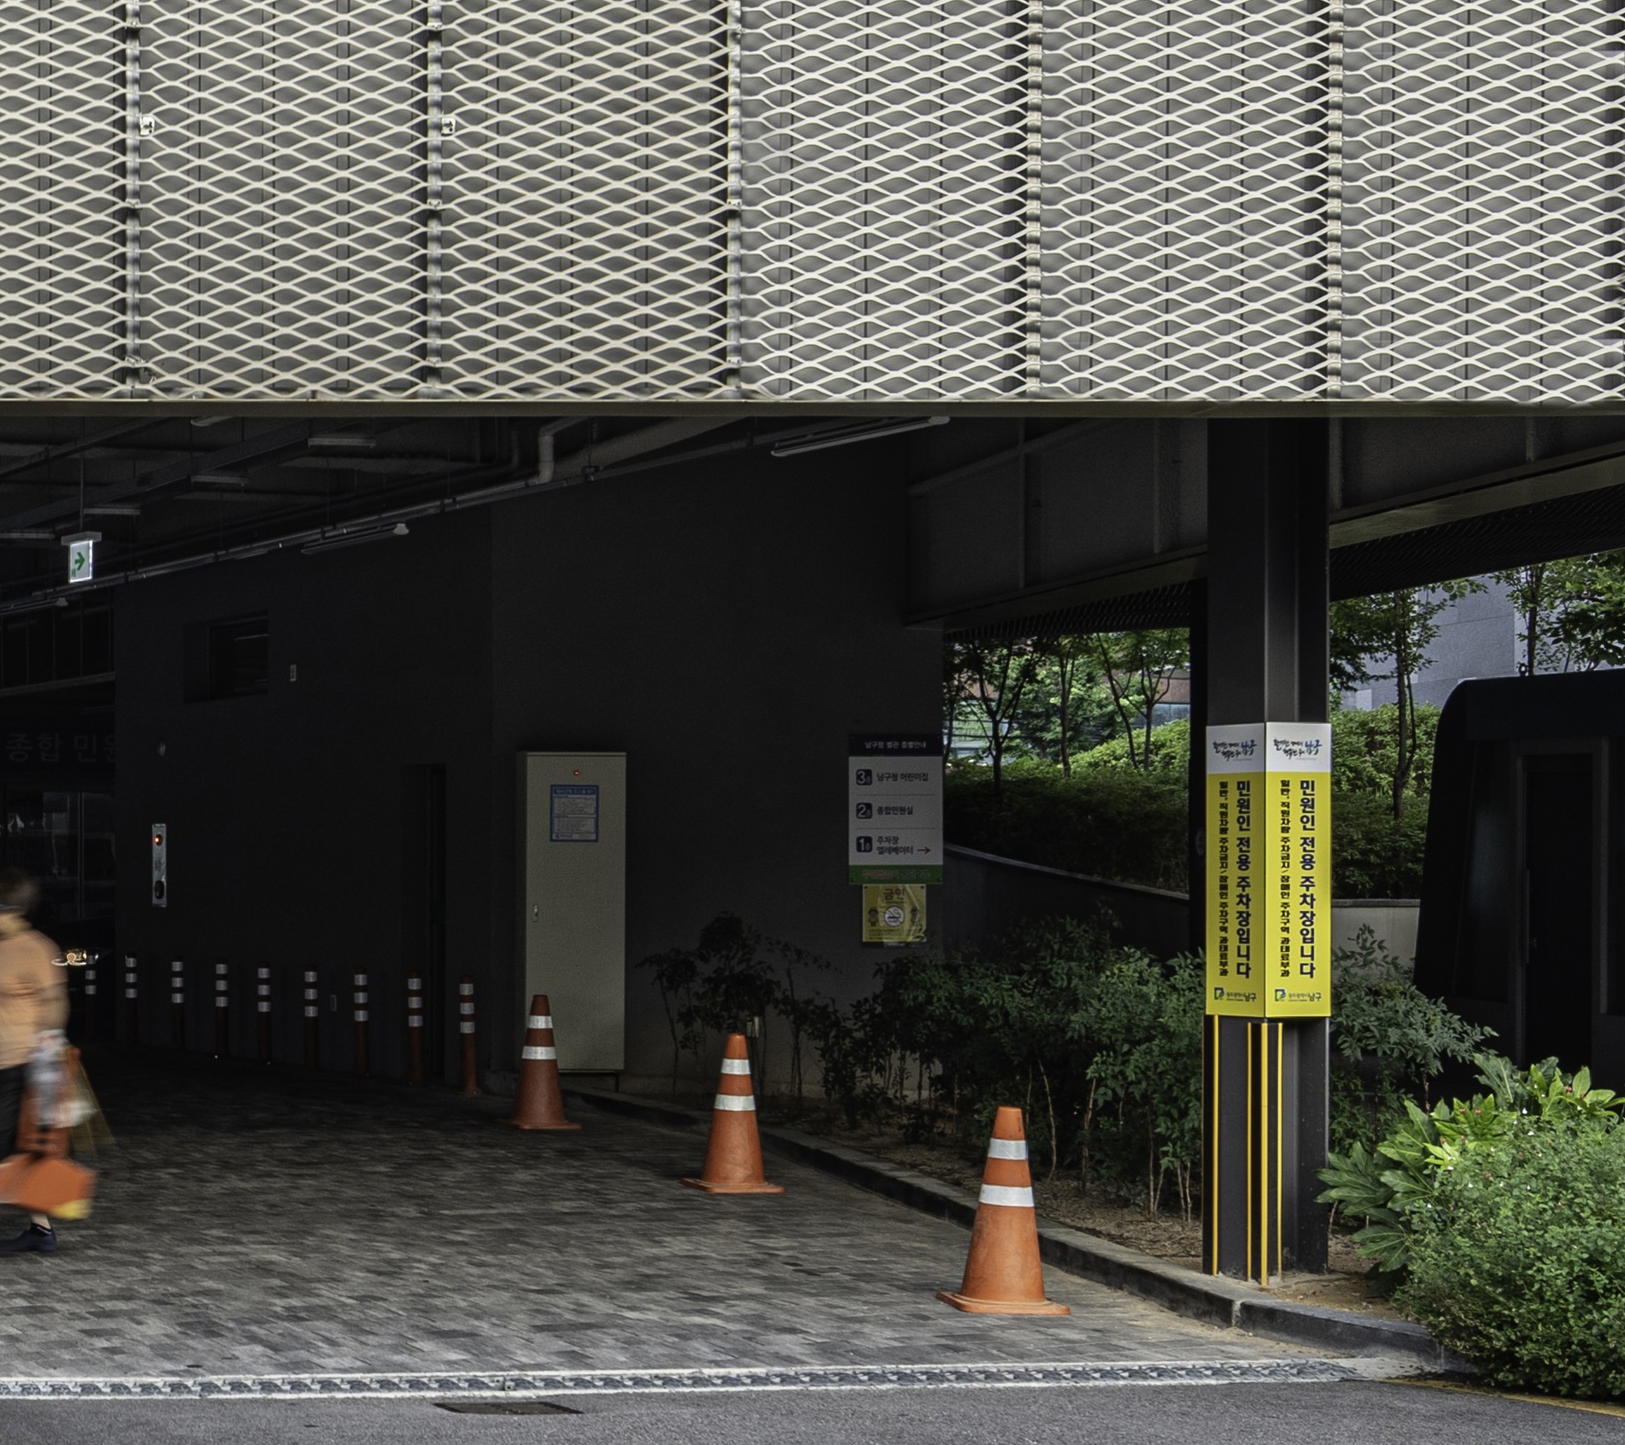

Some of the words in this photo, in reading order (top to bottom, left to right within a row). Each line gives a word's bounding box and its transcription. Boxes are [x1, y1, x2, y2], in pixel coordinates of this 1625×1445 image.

[1236, 780, 1251, 831] 민원인
[1300, 780, 1315, 831] 민원인
[1236, 836, 1251, 871] 전용
[1300, 836, 1315, 871] 전용
[1236, 876, 1251, 979] 주차장입니다
[1300, 876, 1315, 979] 주차장입니다
[1244, 992, 1257, 1002] 남구
[1308, 992, 1322, 1002] 남구
